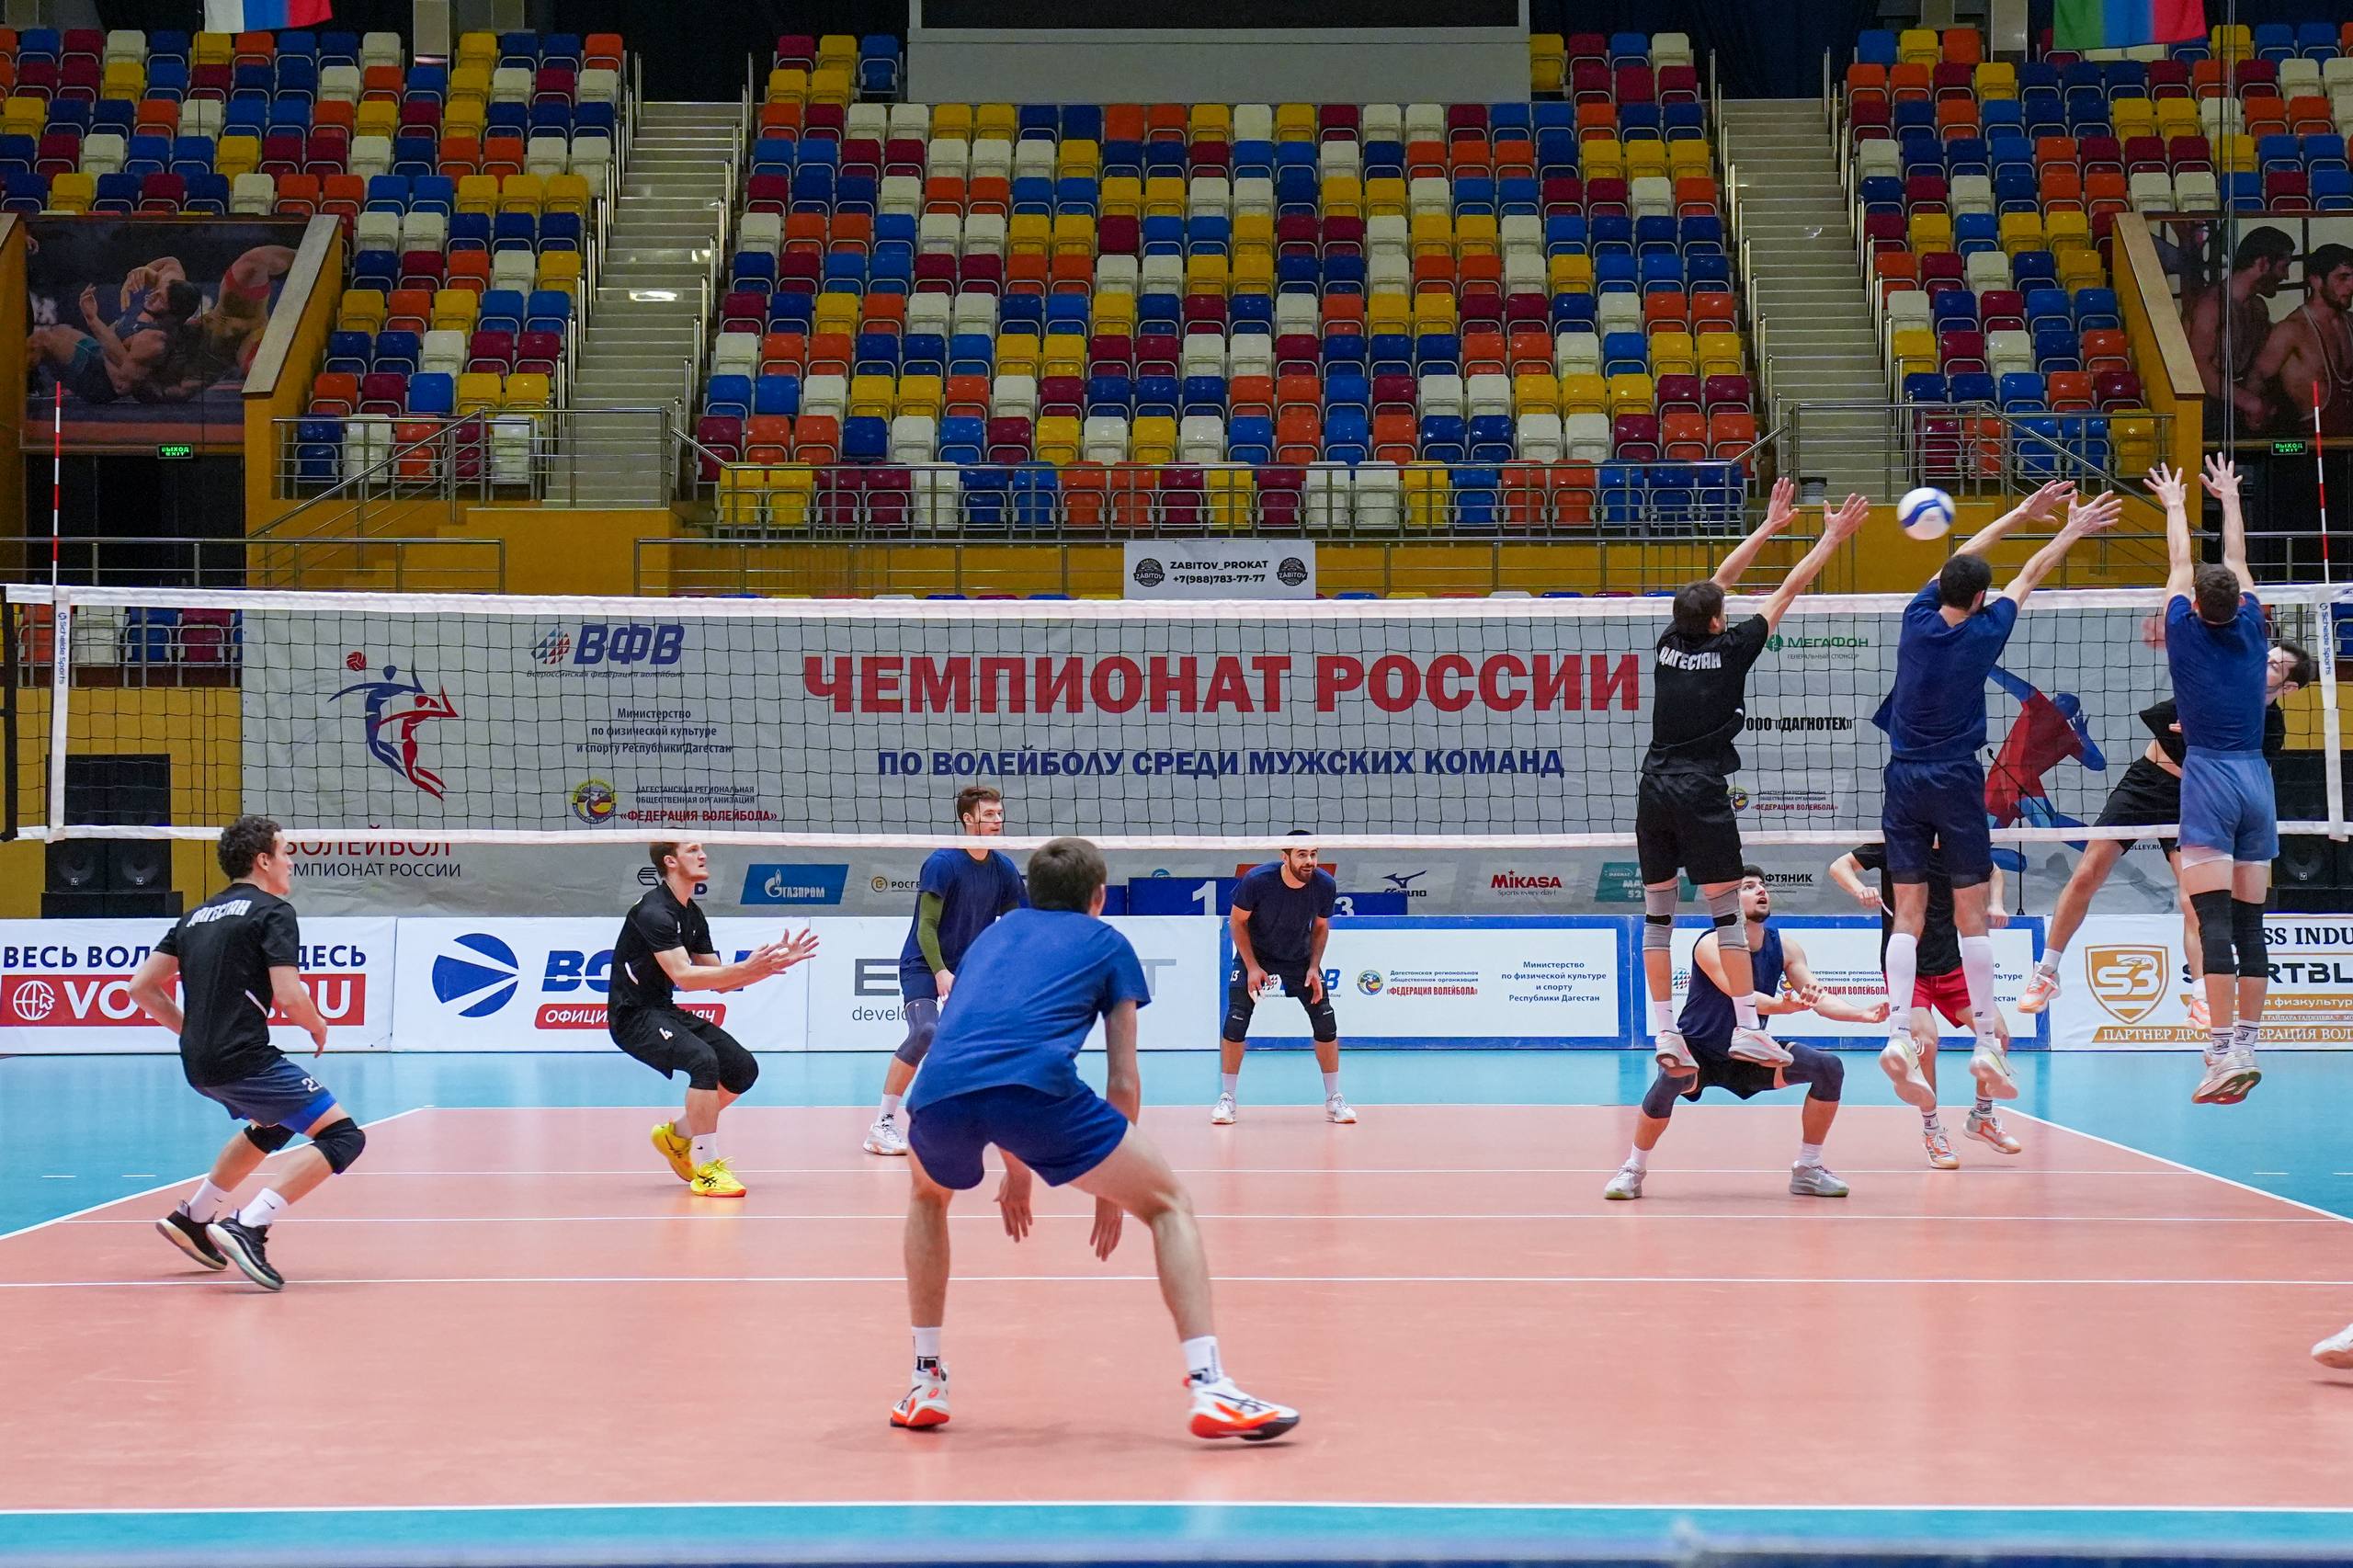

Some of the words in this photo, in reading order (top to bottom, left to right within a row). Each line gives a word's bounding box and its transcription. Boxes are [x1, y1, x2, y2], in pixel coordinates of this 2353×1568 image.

[1170, 561, 1268, 570] ZABITOV_PROKAT
[1173, 574, 1266, 585] +7(988)783-77-77
[574, 624, 685, 665] ВФВ
[2323, 648, 2331, 675] Sports
[804, 656, 1290, 713] ЧЕМПИОНАТ
[1316, 654, 1640, 712] РОССИИ
[617, 708, 691, 720] Министерство
[1746, 717, 1772, 732] ООО
[607, 725, 668, 739] физической
[671, 727, 717, 739] культуре
[577, 744, 583, 753] и
[585, 744, 620, 755] спорту
[622, 743, 682, 756] Республики
[684, 744, 732, 755] Дагестан
[879, 752, 922, 776] ПО
[932, 744, 1124, 776] ВОЛЕЙБОЛУ
[1132, 751, 1238, 779] СРЕДИ
[1250, 750, 1414, 776] МУЖСКИХ
[1425, 749, 1564, 778] КОМАНД
[636, 796, 697, 804] ОБЩЕСТВЕННАЯ
[699, 796, 756, 804] ОРГАНИЗАЦИЯ
[620, 810, 699, 823] «ФЕДЕРАЦИЯ
[702, 809, 778, 822] ВОЛЕЙБОЛА»
[294, 862, 384, 877] МПИОНАТ
[390, 862, 461, 877] РОССИИ
[1765, 873, 1813, 882] ФТЯНИК
[783, 887, 825, 898] ГАЗПРОМ
[1192, 881, 1217, 915] 1
[1335, 897, 1355, 915] 3
[2294, 927, 2353, 945] INDU
[4, 946, 77, 969] ВЕСЬ
[1523, 961, 1585, 970] Министерство
[1824, 986, 1846, 996] РАЦИЯ
[1509, 994, 1559, 1003] Республики
[2275, 997, 2353, 1007] физкультур
[545, 1009, 608, 1025] ОФИЦИ
[2103, 1029, 2171, 1040] ПАРТНЕР
[2257, 1028, 2316, 1041] ЕРАЦИЯ
[2322, 1028, 2353, 1040] ВОЛ
